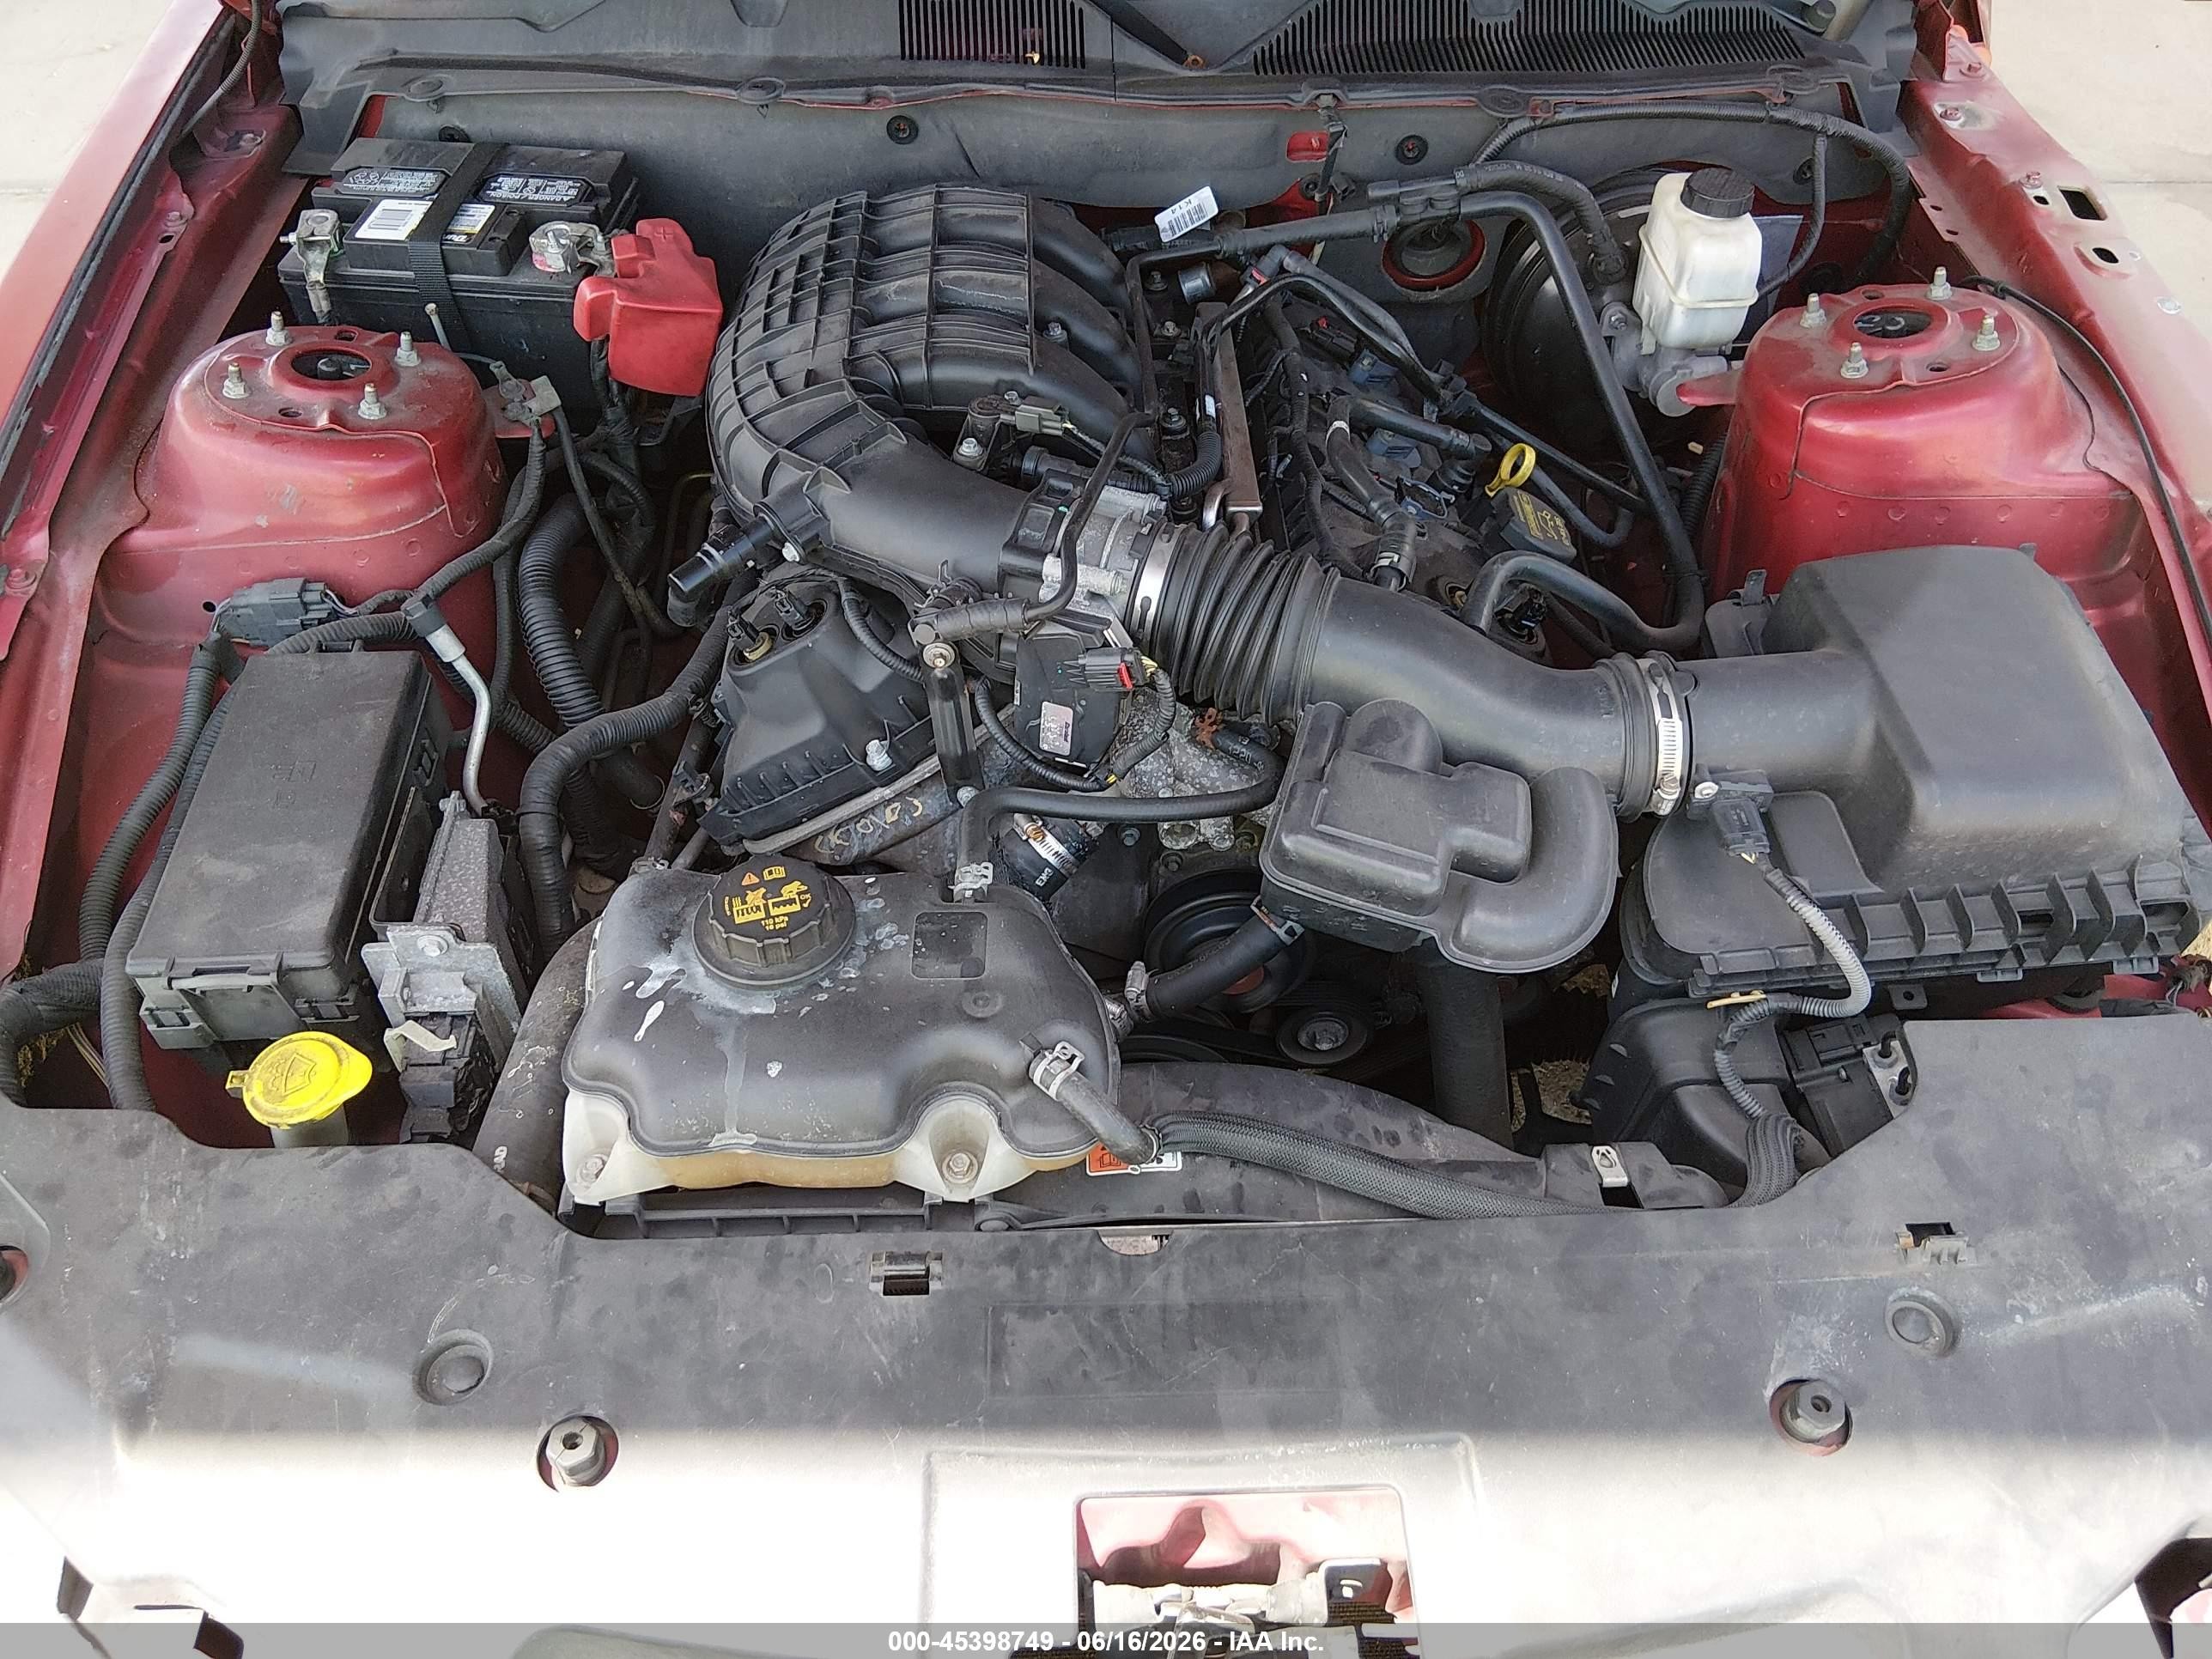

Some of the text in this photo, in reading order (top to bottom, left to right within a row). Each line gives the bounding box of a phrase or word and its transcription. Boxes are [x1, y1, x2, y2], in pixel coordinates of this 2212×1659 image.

[443, 234, 468, 242] Dur
[761, 918, 774, 927] 110
[775, 921, 787, 930] psi
